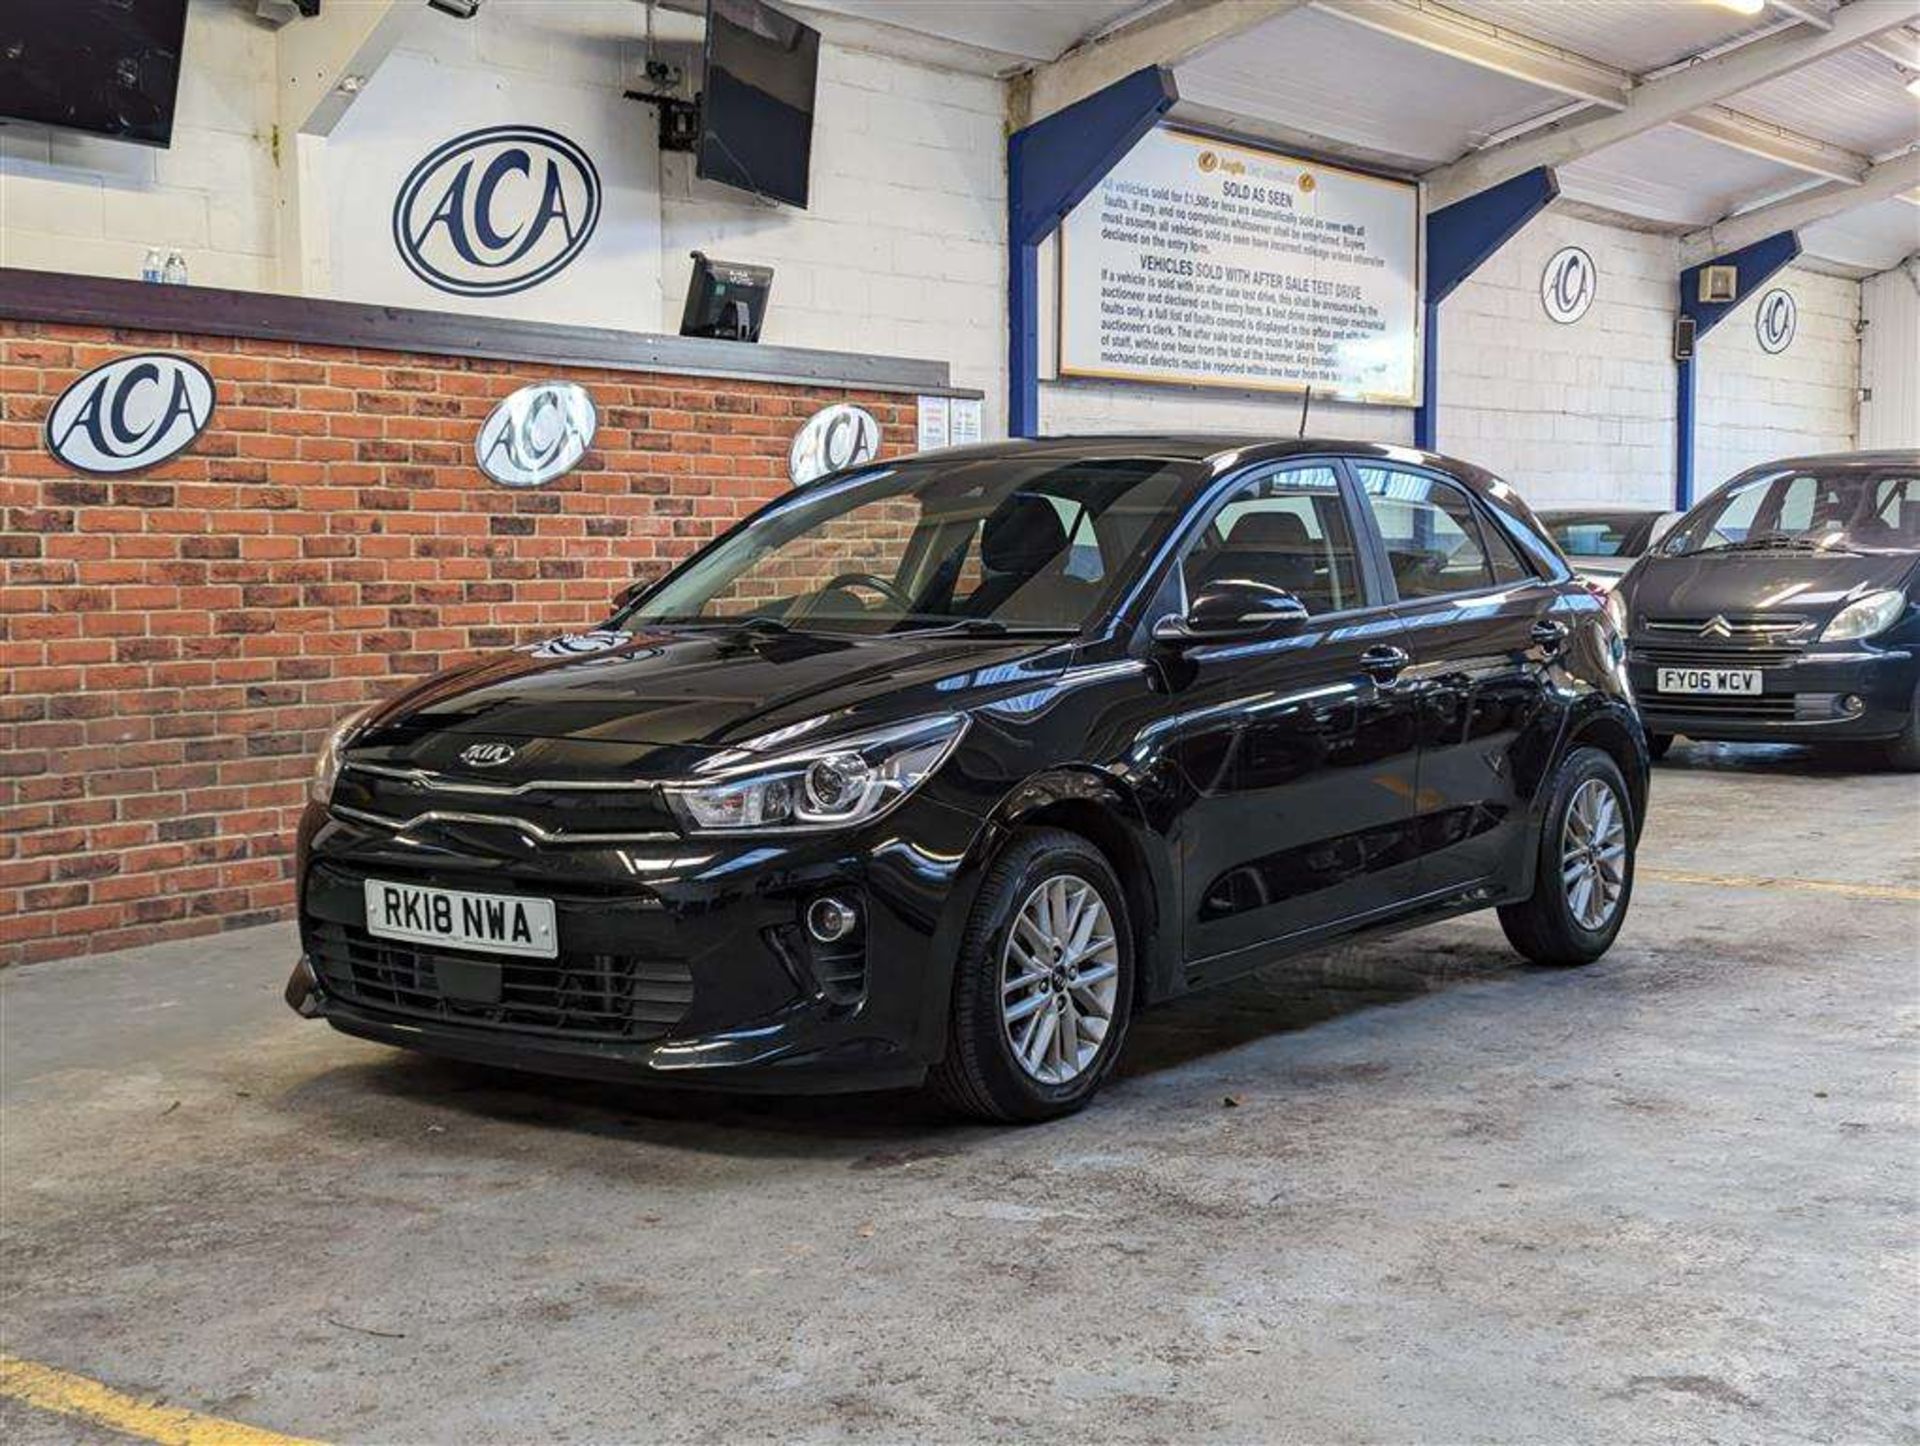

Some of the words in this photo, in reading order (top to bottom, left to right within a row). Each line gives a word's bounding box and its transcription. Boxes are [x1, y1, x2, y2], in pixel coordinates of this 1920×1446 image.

[412, 148, 577, 268] ACA
[1115, 182, 1150, 198] vehicles
[1151, 187, 1169, 201] sold
[1170, 190, 1182, 203] for
[1211, 198, 1219, 209] or
[1251, 206, 1297, 226] automatically
[1222, 180, 1251, 201] SOLD
[1251, 186, 1266, 204] AS
[1267, 188, 1295, 209] SEEN
[1101, 212, 1123, 225] must
[1125, 216, 1156, 231] assume
[1159, 220, 1169, 233] all
[1170, 222, 1203, 238] vehicles
[1204, 228, 1221, 241] sold
[1159, 206, 1173, 218] and
[1176, 209, 1186, 220] no
[1188, 210, 1229, 227] complaints
[1101, 227, 1138, 244] declared
[1140, 234, 1151, 245] on
[1152, 234, 1165, 247] the
[1166, 239, 1188, 254] entry
[1101, 268, 1108, 280] If
[1117, 271, 1146, 286] vehicle
[1147, 276, 1155, 287] is
[1157, 278, 1175, 290] sold
[1177, 280, 1194, 292] with
[1368, 305, 1379, 317] the
[1140, 253, 1194, 276] VEHICLES
[1196, 261, 1222, 280] SOLD
[1225, 266, 1250, 284] WITH
[1253, 270, 1283, 289] AFTER
[1285, 275, 1310, 293] SALE
[1311, 278, 1334, 297] TEST
[1336, 283, 1362, 300] DRIVE
[1545, 255, 1588, 314] ACA
[1101, 286, 1146, 303] auctioneer
[1147, 293, 1162, 304] and
[1163, 295, 1200, 309] declared
[1201, 299, 1210, 310] on
[1212, 300, 1223, 312] the
[1225, 302, 1243, 318] entry
[1350, 317, 1386, 332] mechanical
[1101, 301, 1125, 316] faults
[1155, 307, 1168, 320] full
[1184, 311, 1193, 323] of
[1194, 312, 1215, 326] faults
[1216, 316, 1246, 330] covered
[1255, 320, 1290, 336] displayed
[1312, 325, 1331, 338] office
[1101, 334, 1110, 346] of
[1134, 338, 1159, 351] within
[1161, 341, 1176, 353] one
[1178, 341, 1196, 355] hour
[1197, 344, 1215, 356] from
[1216, 345, 1228, 358] the
[1243, 347, 1251, 360] of
[1252, 349, 1264, 361] the
[1178, 324, 1192, 338] The
[1193, 328, 1212, 341] after
[1101, 351, 1148, 366] mechanical
[1149, 355, 1179, 369] defects
[1181, 359, 1201, 371] must
[1202, 359, 1212, 371] be
[1213, 362, 1245, 376] reported
[56, 362, 200, 458] ACA
[483, 390, 587, 472] ACA
[1664, 671, 1711, 690] FY06
[1716, 673, 1753, 691] WCV
[466, 742, 506, 761] KIA
[383, 886, 453, 934] RK18
[462, 897, 532, 944] NWA
